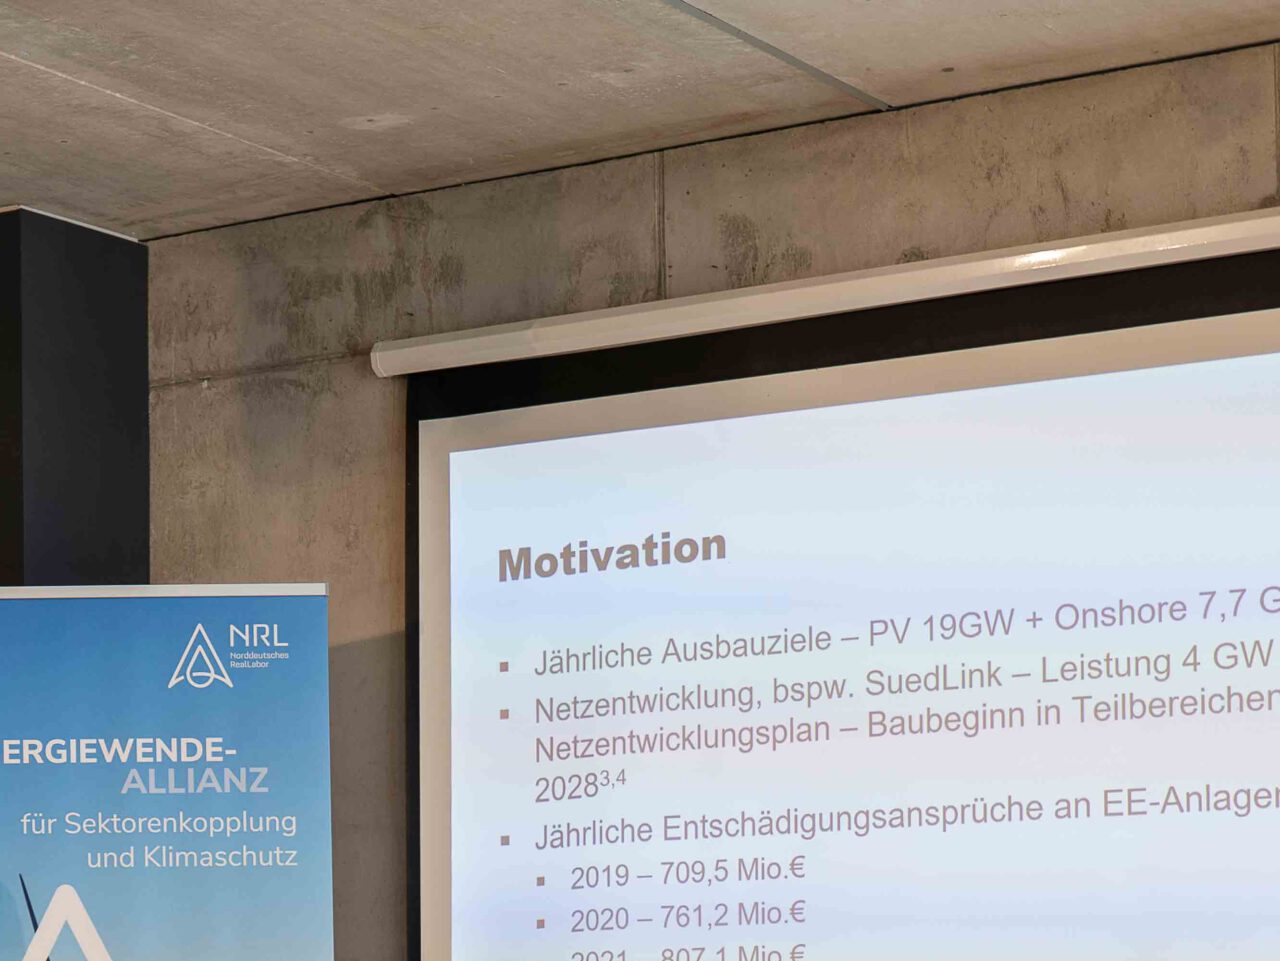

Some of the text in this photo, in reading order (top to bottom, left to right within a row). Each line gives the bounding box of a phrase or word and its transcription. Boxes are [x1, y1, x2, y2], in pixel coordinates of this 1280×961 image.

[499, 531, 726, 582] Motivation
[230, 624, 288, 647] NRL
[534, 642, 652, 676] Jährliche
[661, 626, 831, 664] Ausbauziele
[870, 617, 911, 646] PV
[923, 608, 1015, 641] 19GW
[1026, 611, 1043, 629] +
[1055, 599, 1187, 630] Onshore
[1199, 588, 1247, 623] 7,7
[230, 651, 289, 659] Norddeutsches
[536, 684, 761, 723] Netzentwicklung,
[774, 678, 853, 708] bspw.
[866, 661, 1002, 696] SuedLink
[1042, 652, 1170, 683] Leistung
[1182, 645, 1200, 672] 4
[1214, 639, 1274, 669] GW
[536, 717, 829, 763] Netzentwicklungsplan
[869, 703, 1024, 738] Baubeginn
[1037, 699, 1060, 726] in
[120, 767, 269, 794] ALLIANZ
[20, 811, 297, 838] für Sektorenkopplung
[535, 818, 653, 850] Jährliche
[664, 795, 1043, 841] Entschädigungsansprüche
[1055, 797, 1090, 819] an
[87, 845, 298, 868] und Klimaschutz
[571, 864, 629, 890] 2019
[661, 859, 728, 887] 709,5
[738, 855, 805, 881] Mio.€
[571, 907, 629, 932] 2020
[661, 903, 728, 930] 761,2
[738, 900, 806, 925] Mio.€
